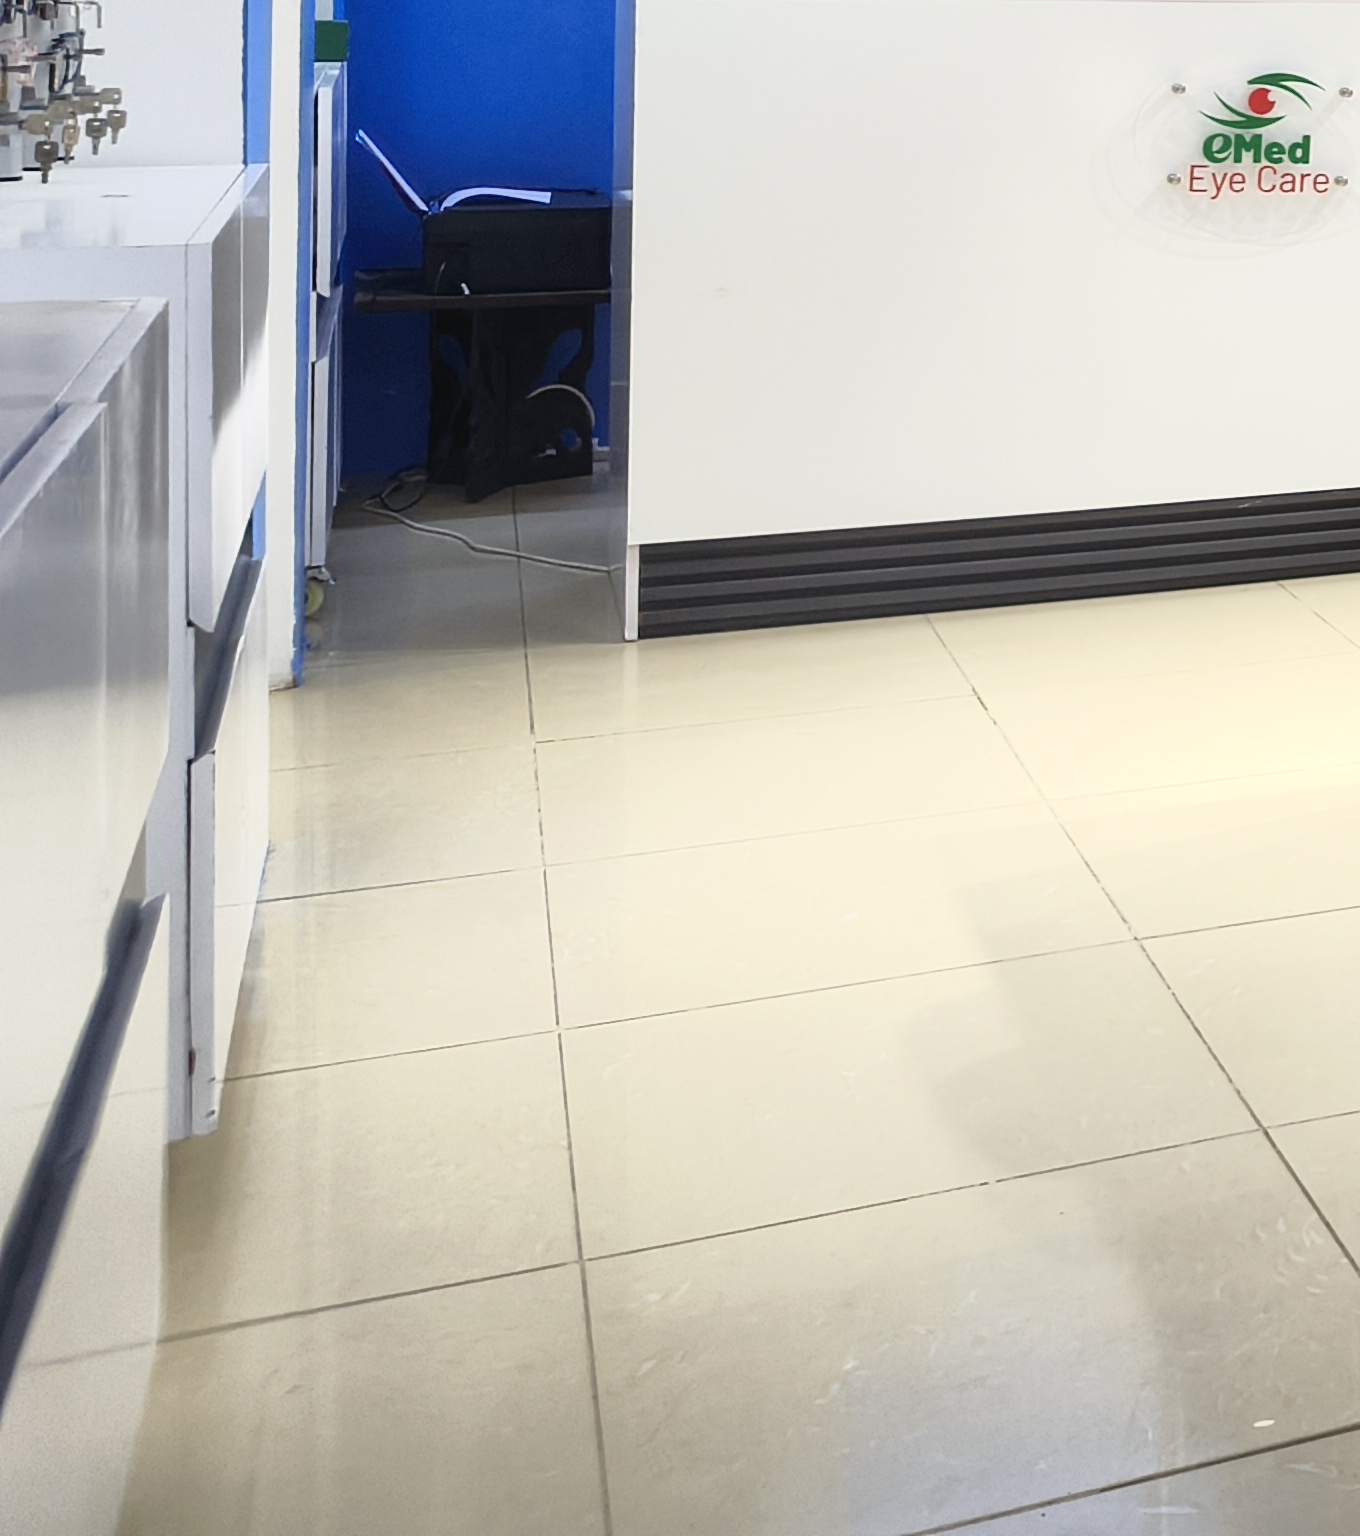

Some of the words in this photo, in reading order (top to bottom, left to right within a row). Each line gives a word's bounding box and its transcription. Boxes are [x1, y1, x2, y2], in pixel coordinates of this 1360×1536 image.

[1202, 132, 1312, 165] eMed
[1189, 165, 1246, 200] Eye
[1257, 165, 1330, 194] Care
